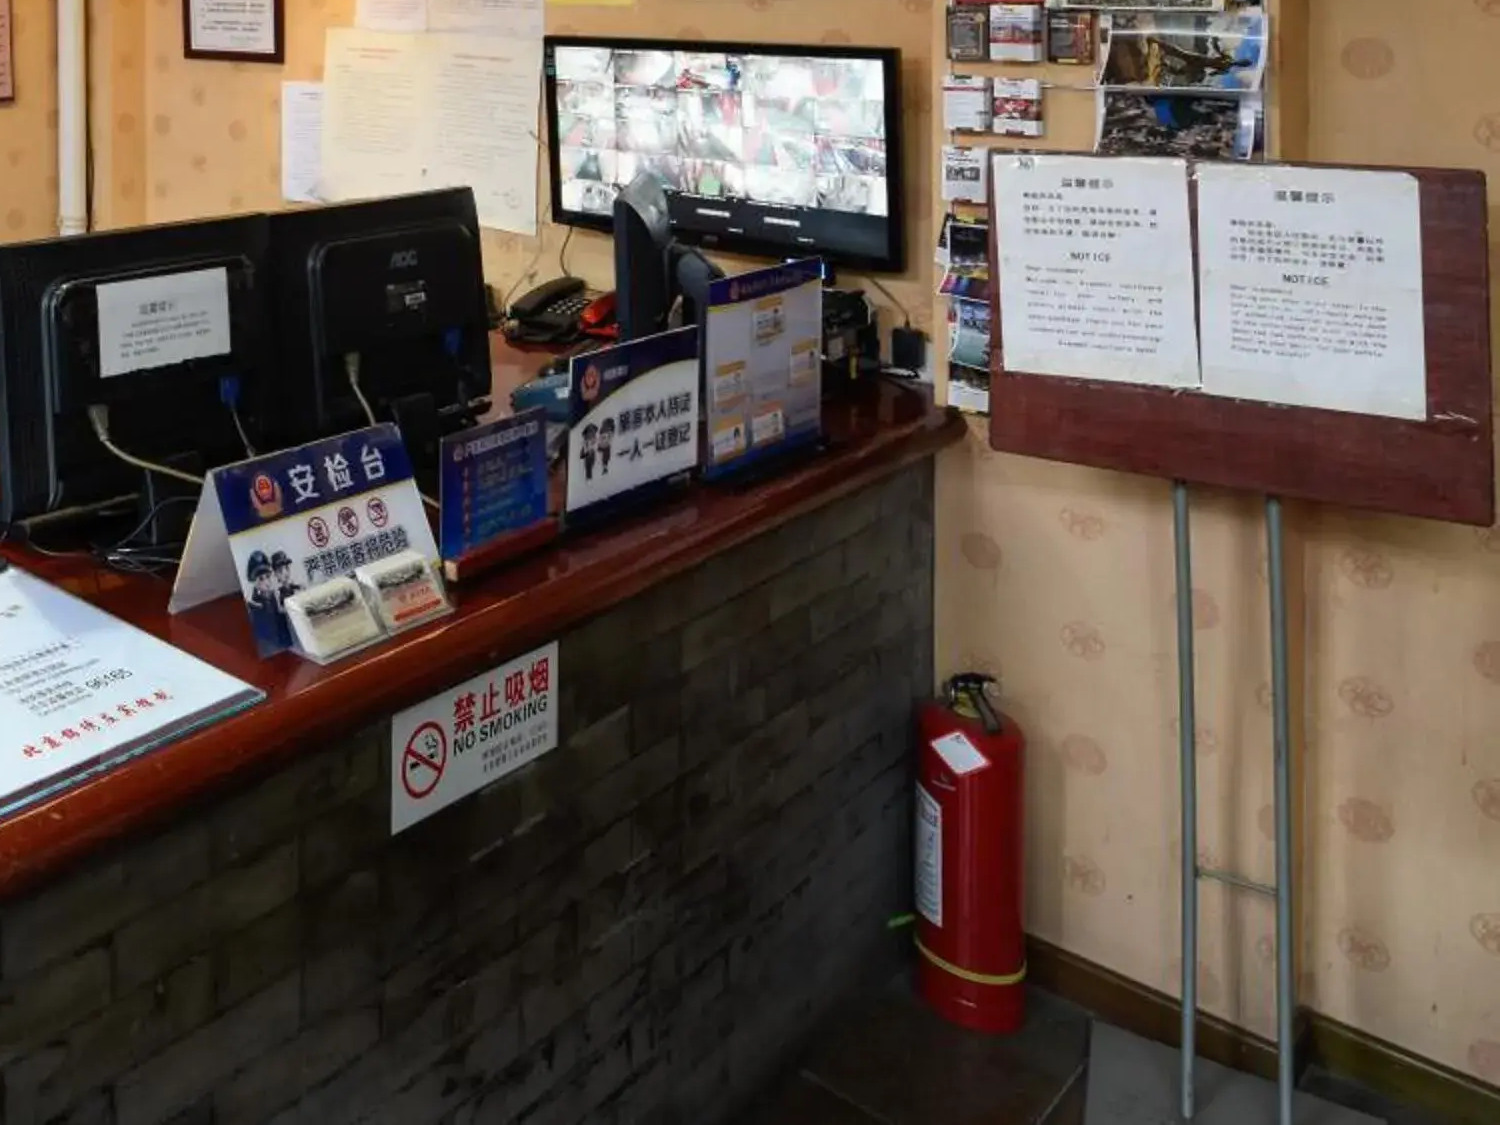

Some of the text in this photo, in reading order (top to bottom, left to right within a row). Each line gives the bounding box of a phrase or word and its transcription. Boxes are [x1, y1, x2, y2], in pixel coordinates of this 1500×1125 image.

[1274, 190, 1336, 203] 温馨提示
[1070, 251, 1112, 263] NOTICE
[1282, 274, 1331, 286] NOTICE
[617, 422, 691, 462] 一人一证登记
[287, 444, 386, 504] 安检台
[453, 657, 549, 735] 禁止吸烟
[453, 732, 476, 757] NO
[479, 694, 548, 743] SMOKING
